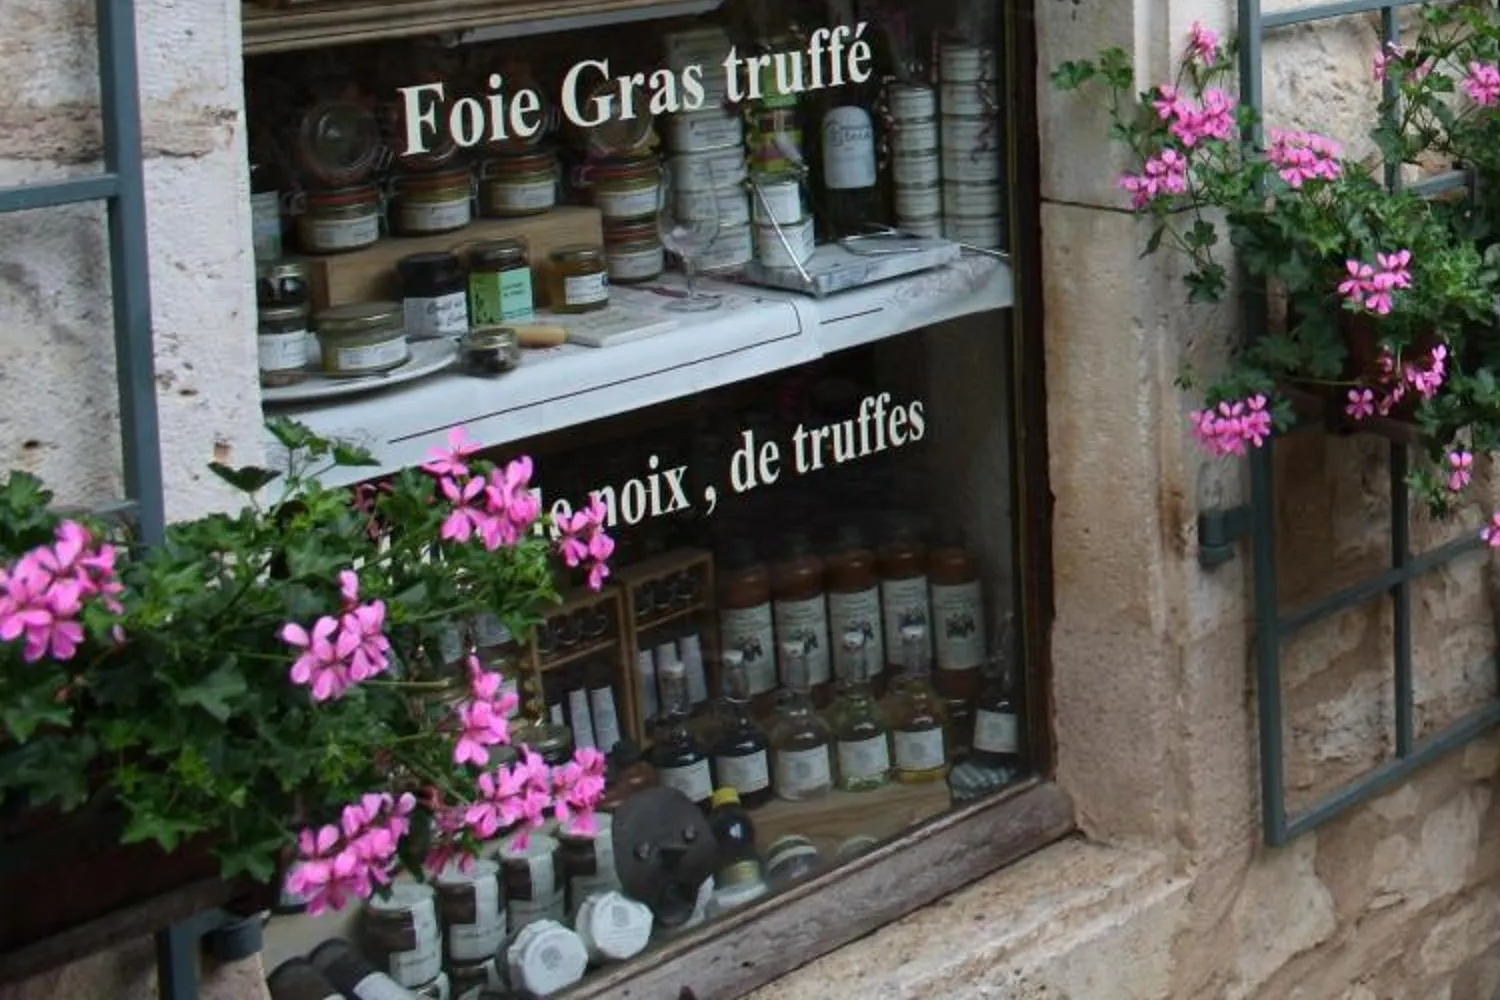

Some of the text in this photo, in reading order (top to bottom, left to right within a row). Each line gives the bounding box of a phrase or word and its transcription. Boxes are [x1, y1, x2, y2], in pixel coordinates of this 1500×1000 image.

[397, 21, 873, 157] Foie Gras truffé
[730, 428, 780, 494] de
[792, 391, 926, 475] truffes
